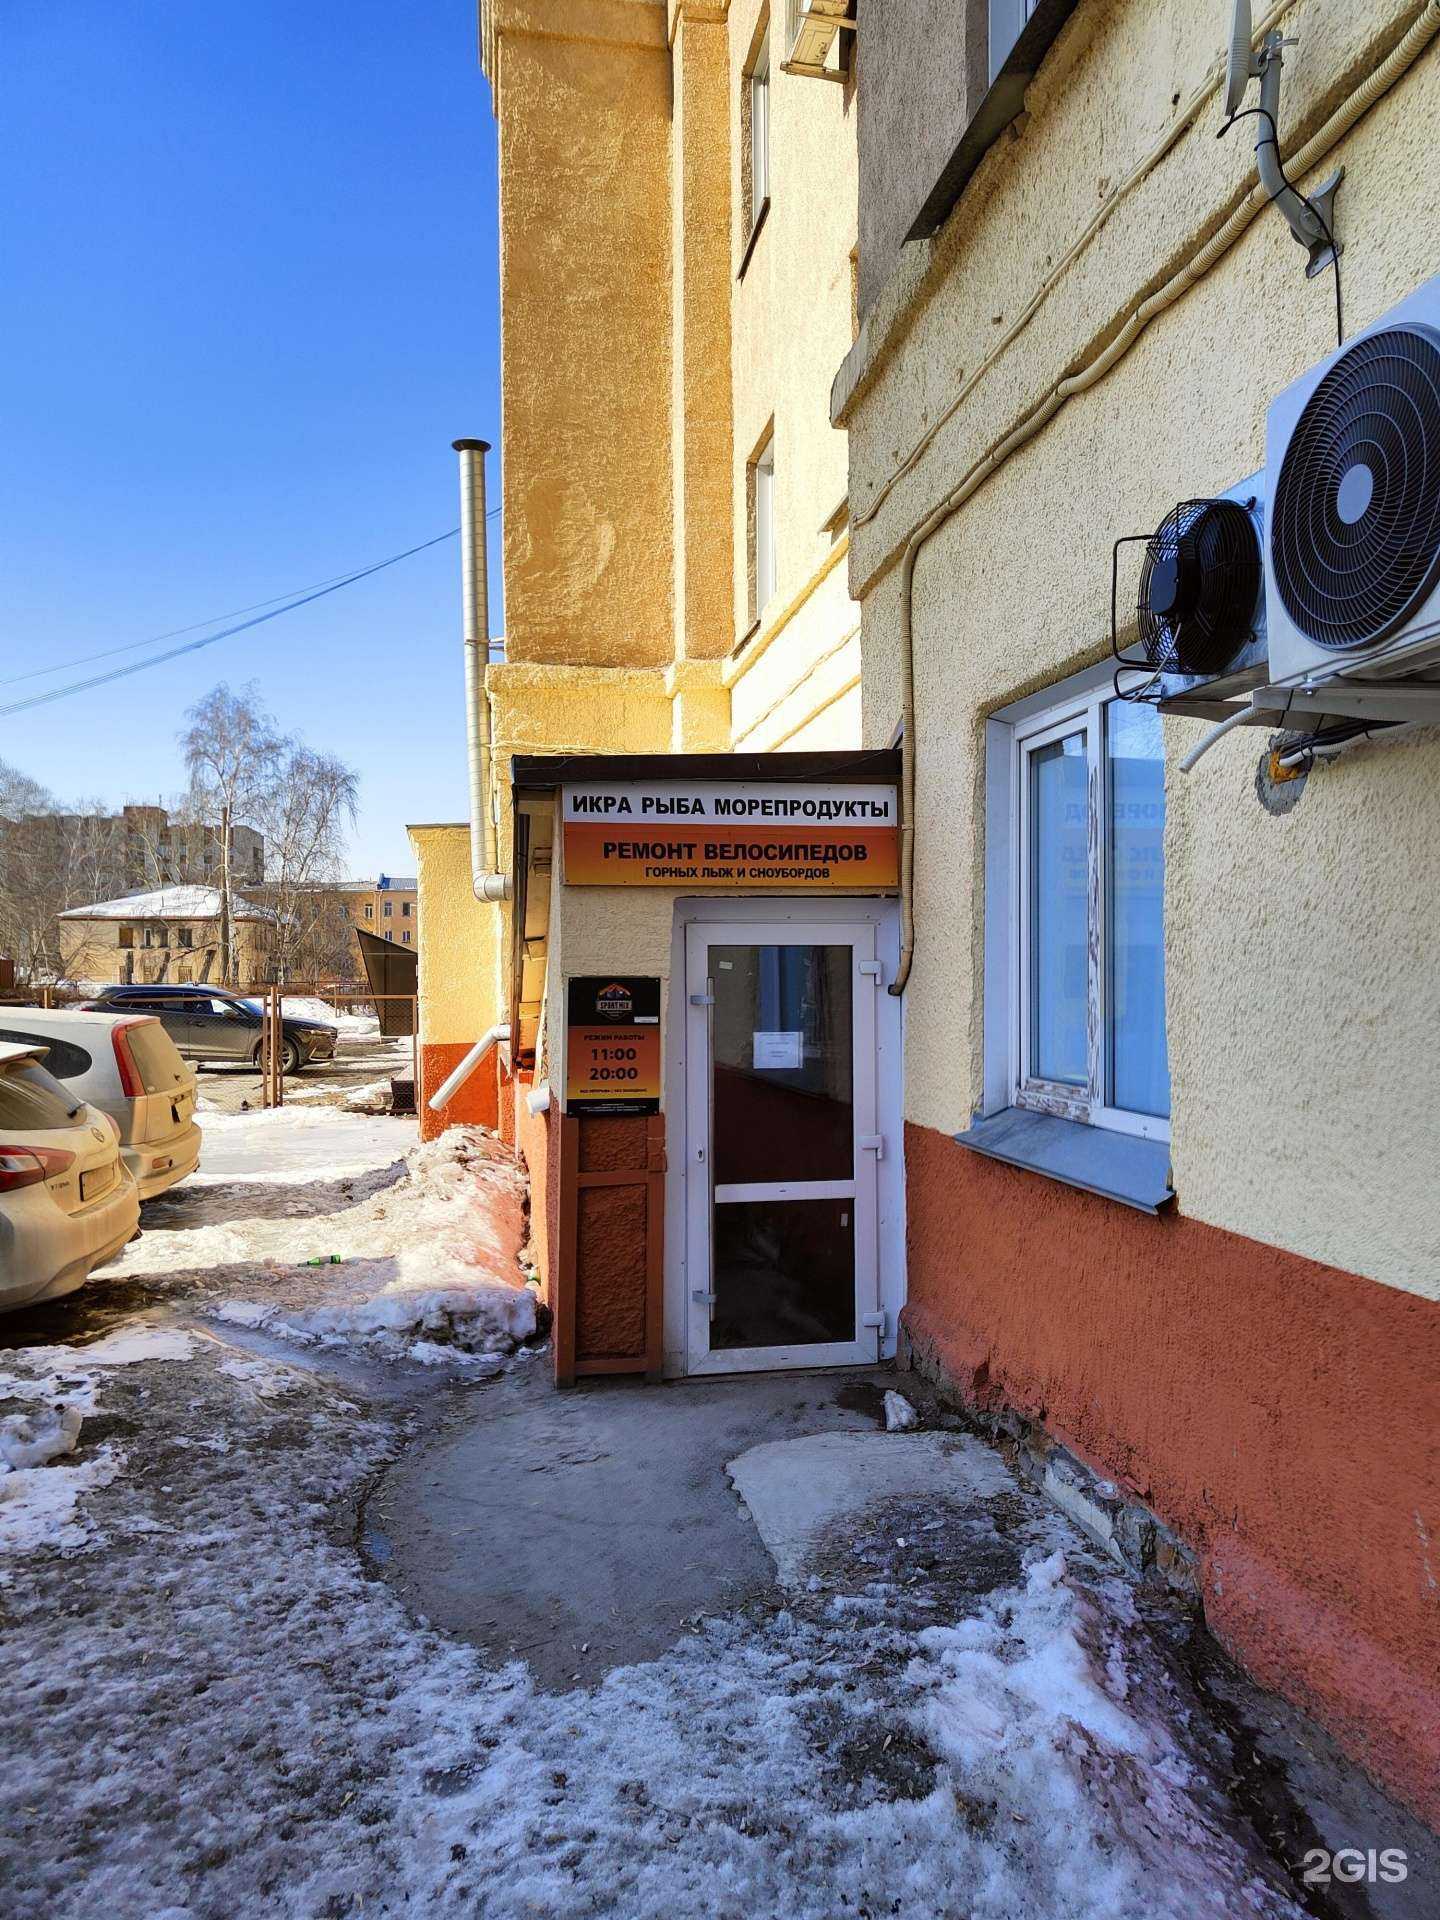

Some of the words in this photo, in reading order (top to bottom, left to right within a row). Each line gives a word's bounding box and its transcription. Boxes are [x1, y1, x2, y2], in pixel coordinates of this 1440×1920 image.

[572, 796, 632, 814] ИКРА
[641, 797, 705, 816] РЫБА
[714, 798, 889, 820] МОРЕПРОДУКТЫ
[603, 842, 697, 861] РЕМОНТ
[705, 843, 867, 863] ВЕЛОСИПЕДОВ
[645, 866, 699, 879] ГОРНЫХ
[701, 866, 733, 879] ЛЫЖ
[737, 867, 746, 878] И
[749, 867, 830, 881] СНОУБОРДОВ
[592, 1048, 636, 1060] 11:00
[590, 1067, 637, 1080] 20:00
